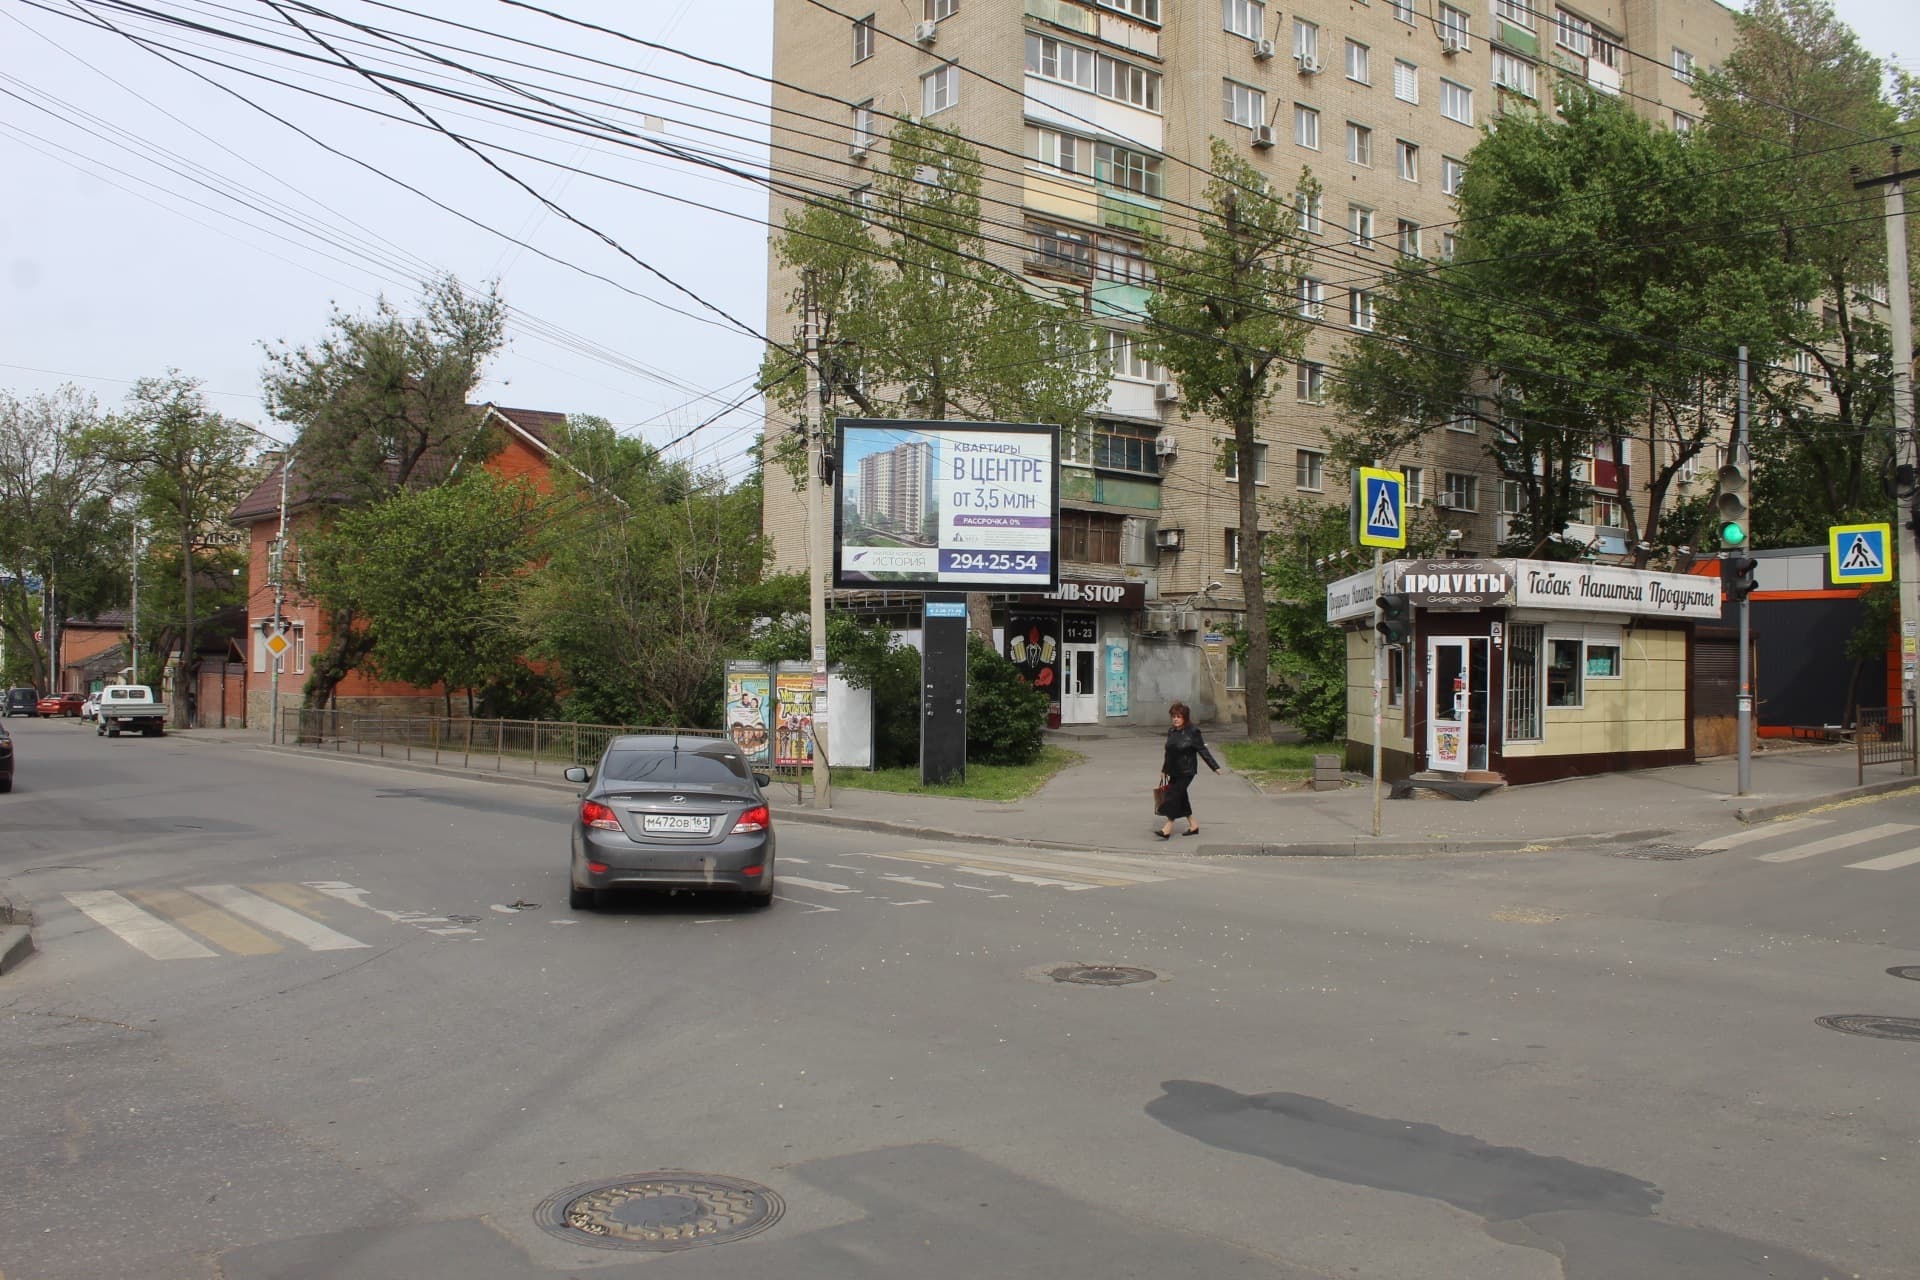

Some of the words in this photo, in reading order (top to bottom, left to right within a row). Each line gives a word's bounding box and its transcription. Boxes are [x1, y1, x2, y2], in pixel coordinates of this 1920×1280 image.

[953, 442, 1021, 454] КВАРТИРЫ
[953, 456, 965, 480] В
[971, 457, 1043, 484] ЦЕНТРЕ
[953, 491, 971, 507] ОТ
[974, 487, 999, 511] 3,5
[963, 517, 1008, 526] РАССРОЧКА
[1009, 518, 1021, 526] 0%
[872, 556, 926, 568] ИСТОРИЯ
[1405, 573, 1506, 594] ПРОДУКТЫ
[1527, 570, 1572, 596] Табак
[1579, 574, 1643, 602] Напитки
[1650, 580, 1715, 611] Продукты
[1067, 628, 1076, 638] 11
[1082, 628, 1093, 638] 23
[693, 815, 709, 826] 161
